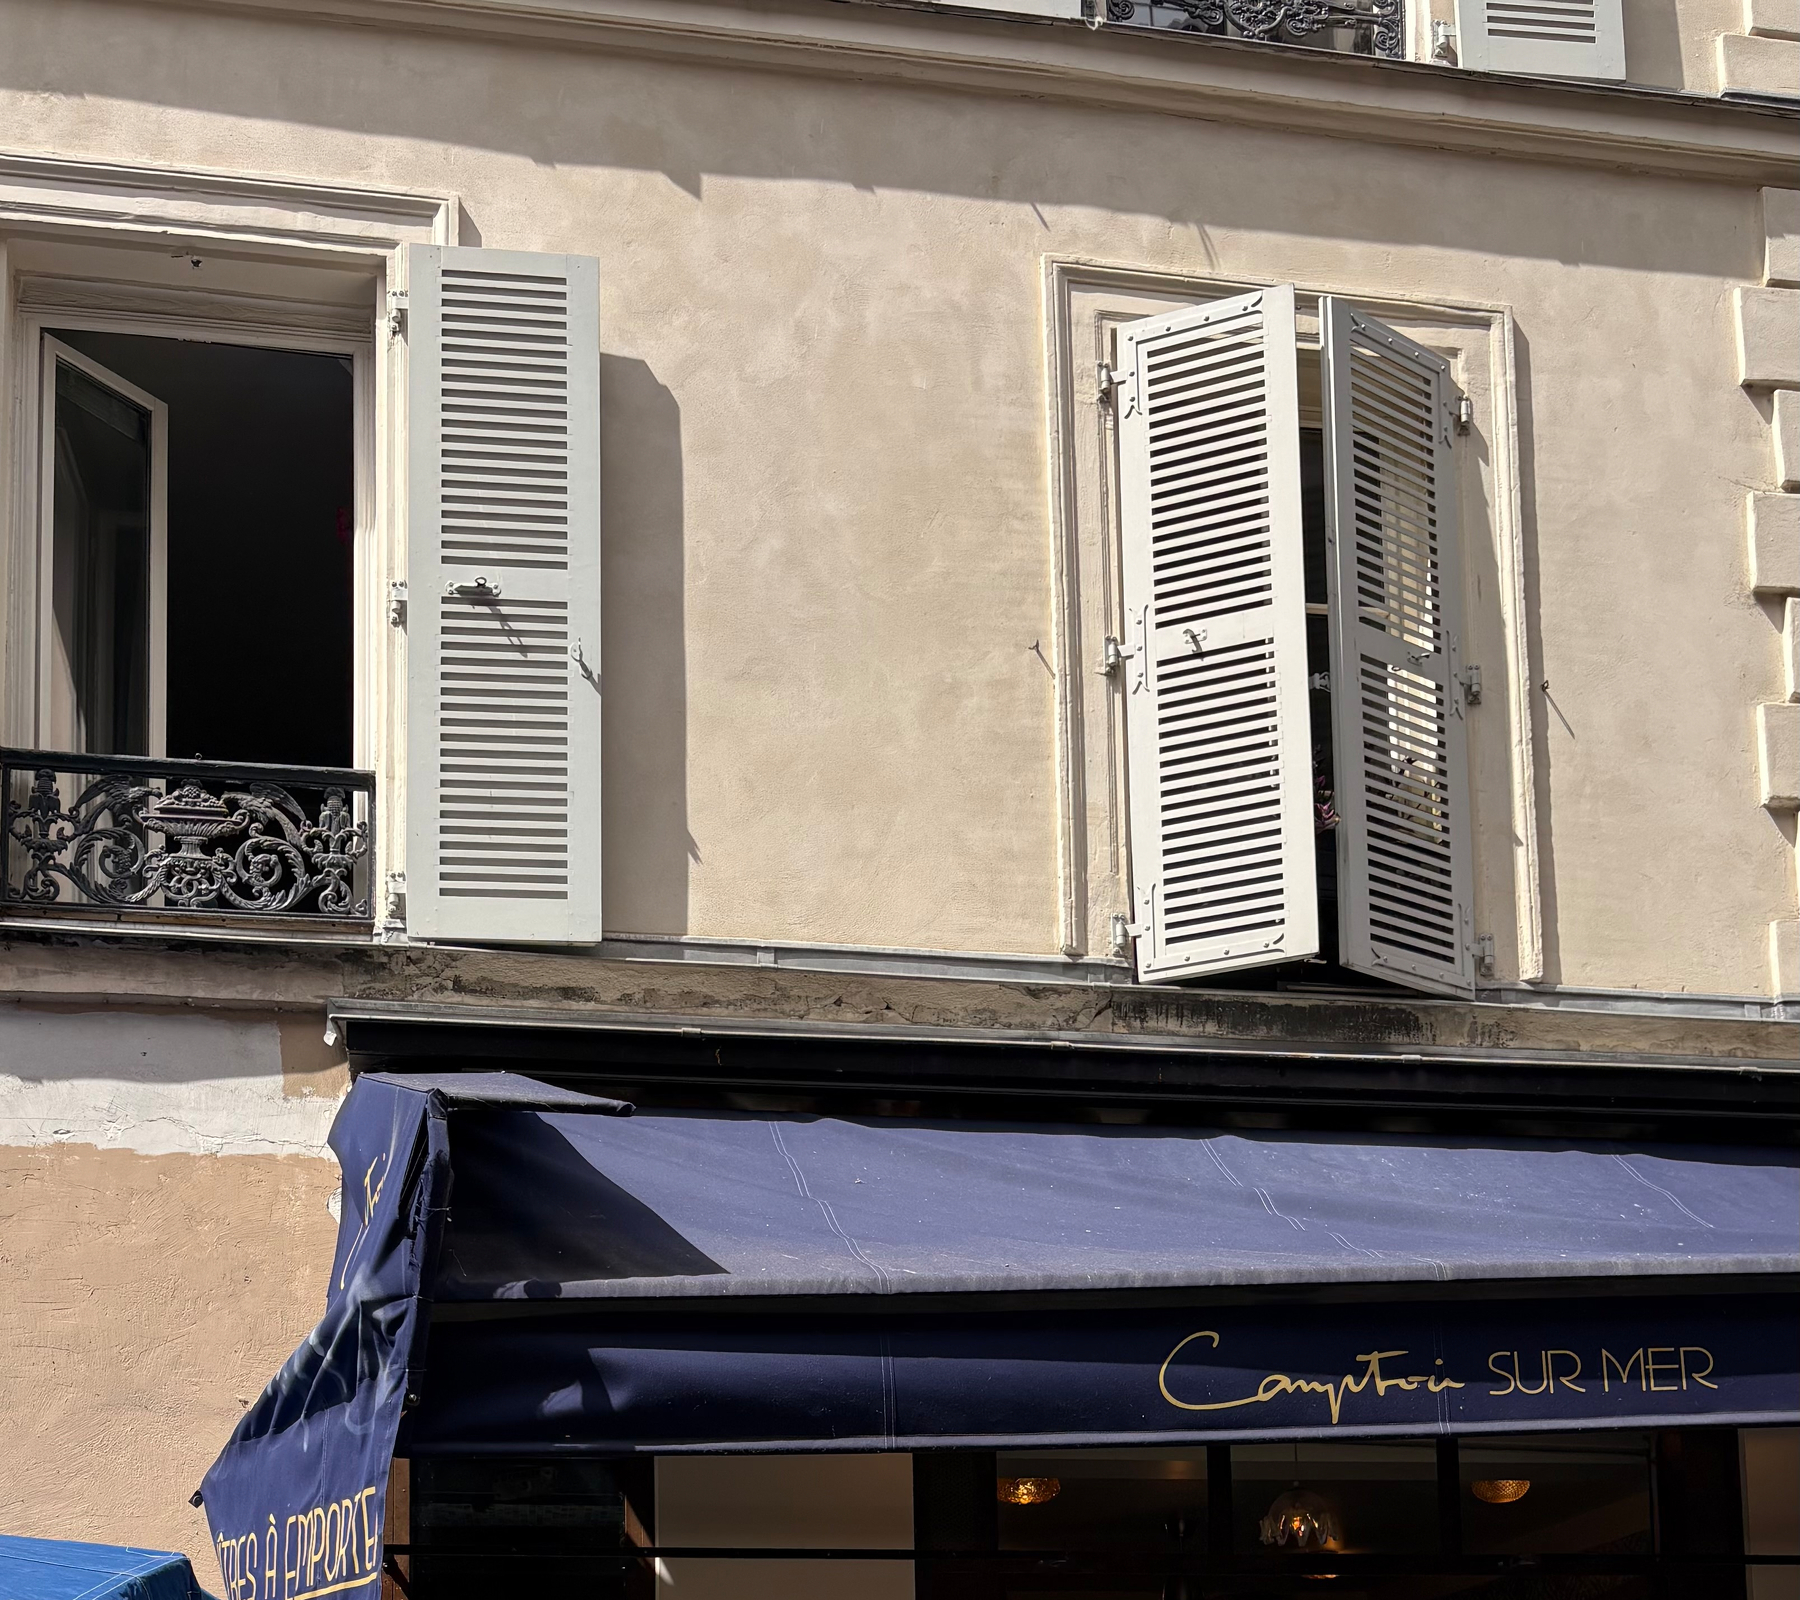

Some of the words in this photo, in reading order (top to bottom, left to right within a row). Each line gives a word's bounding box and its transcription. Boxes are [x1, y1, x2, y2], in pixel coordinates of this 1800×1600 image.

[1488, 1348, 1586, 1396] SUR
[1602, 1346, 1719, 1393] MER
[264, 1513, 278, 1600] À
